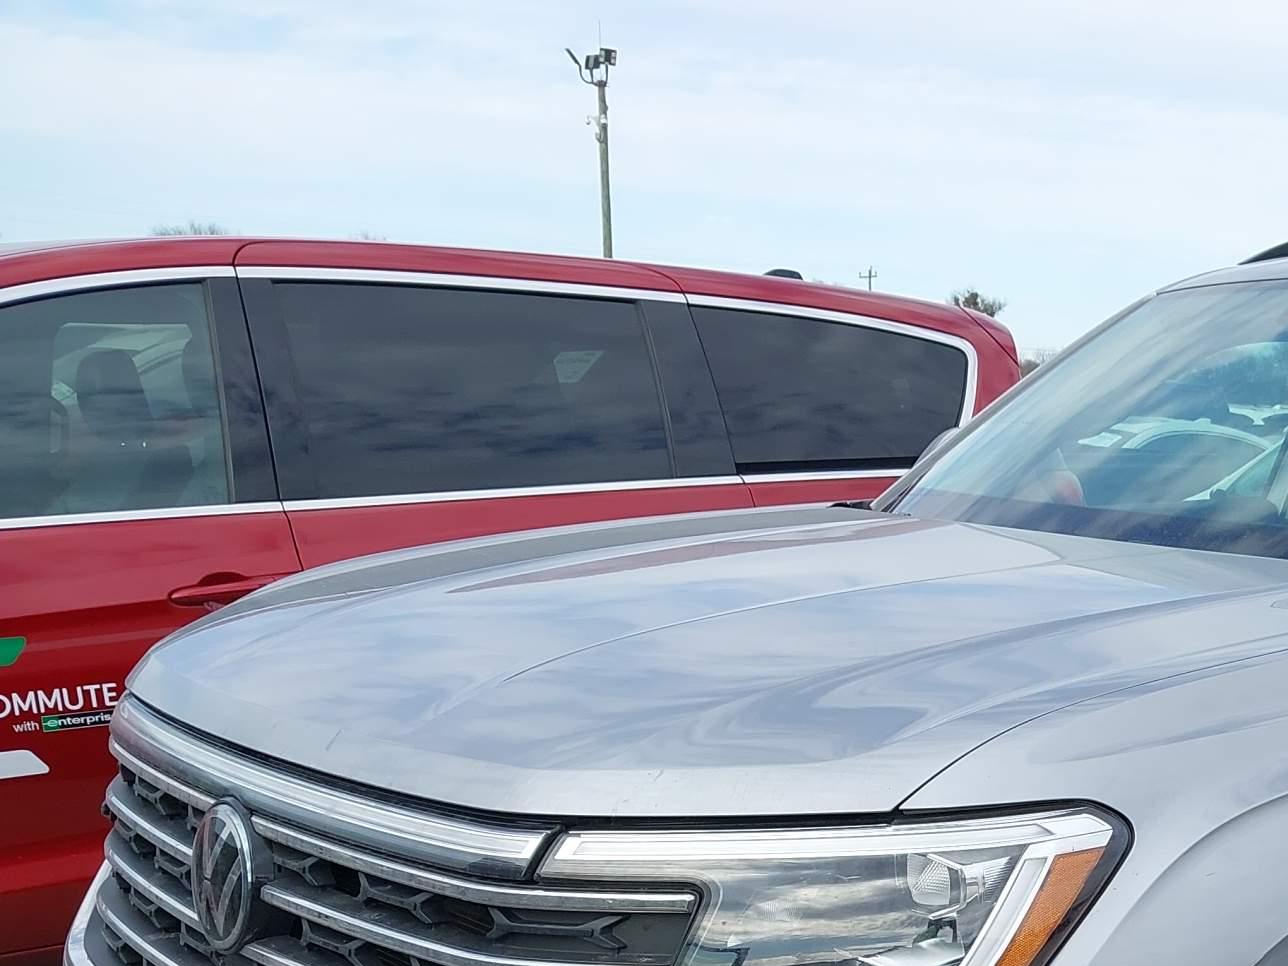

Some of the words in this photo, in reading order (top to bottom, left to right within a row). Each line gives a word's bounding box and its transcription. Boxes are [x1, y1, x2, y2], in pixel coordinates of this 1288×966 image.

[0, 682, 118, 719] OMMUTE
[12, 720, 40, 732] with
[46, 713, 111, 727] enterpris
